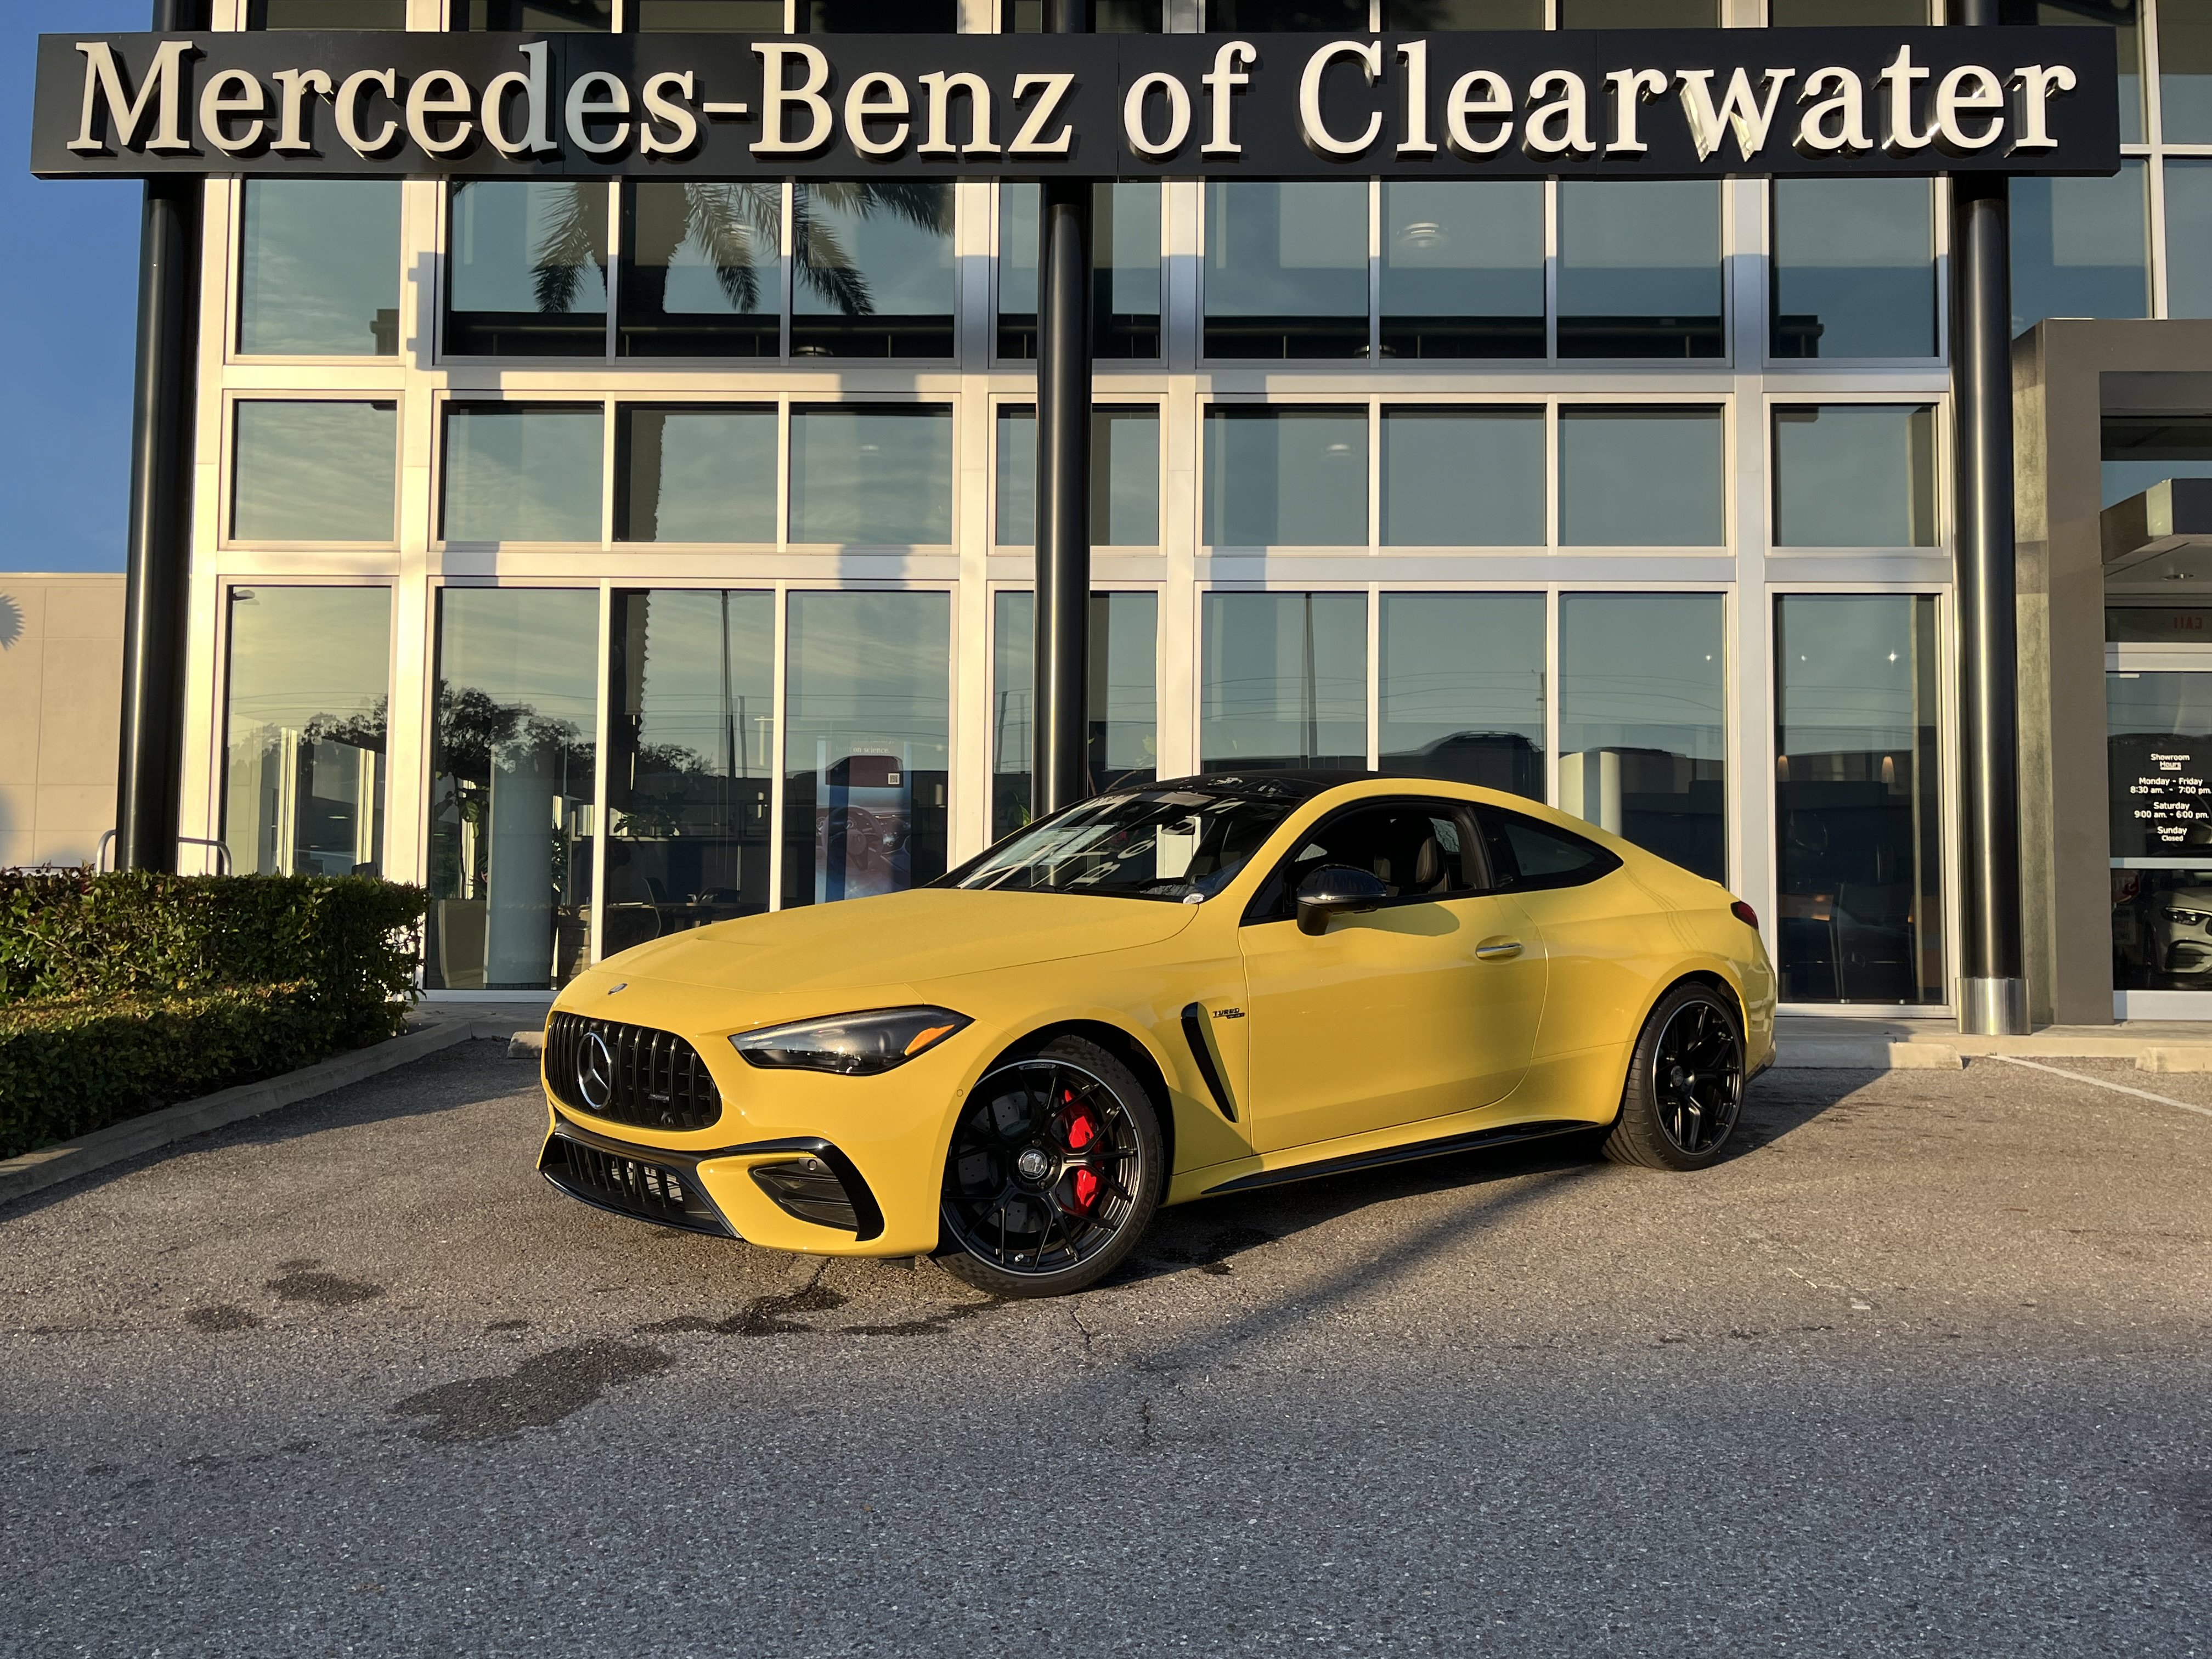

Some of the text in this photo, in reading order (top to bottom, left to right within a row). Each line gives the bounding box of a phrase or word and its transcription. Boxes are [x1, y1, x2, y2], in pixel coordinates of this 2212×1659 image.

[66, 40, 2077, 162] Mercedes-Benz of Clearwater
[2138, 777, 2170, 786] Monday
[2179, 777, 2203, 786] Friday
[2130, 786, 2148, 794] 8:30
[2153, 802, 2190, 811] Saturday
[2157, 826, 2187, 835] Sunday
